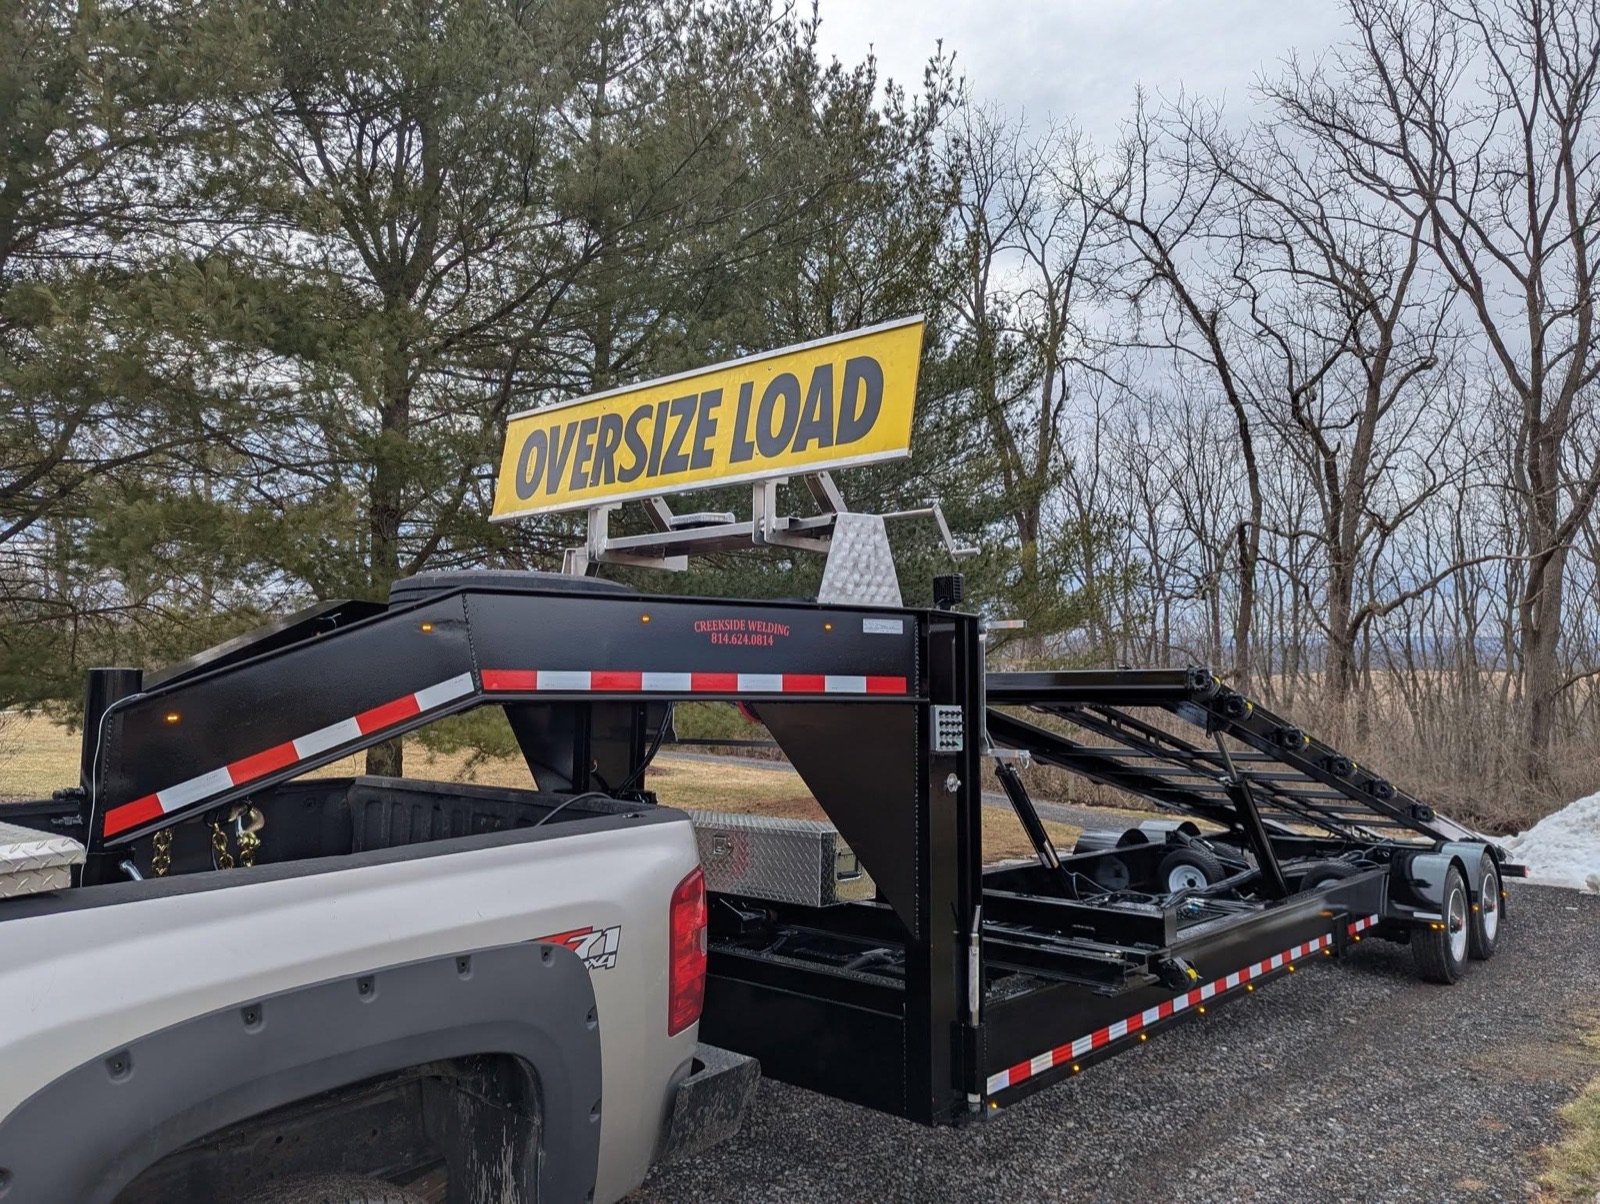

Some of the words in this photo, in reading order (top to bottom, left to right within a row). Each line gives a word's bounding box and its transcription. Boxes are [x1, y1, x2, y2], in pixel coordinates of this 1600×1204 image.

[515, 388, 722, 500] OVERSIZE
[729, 355, 885, 464] LOAD
[694, 619, 745, 633] CREEKSIDE
[748, 620, 790, 636] WELDING
[711, 632, 774, 646] 814.624.0814
